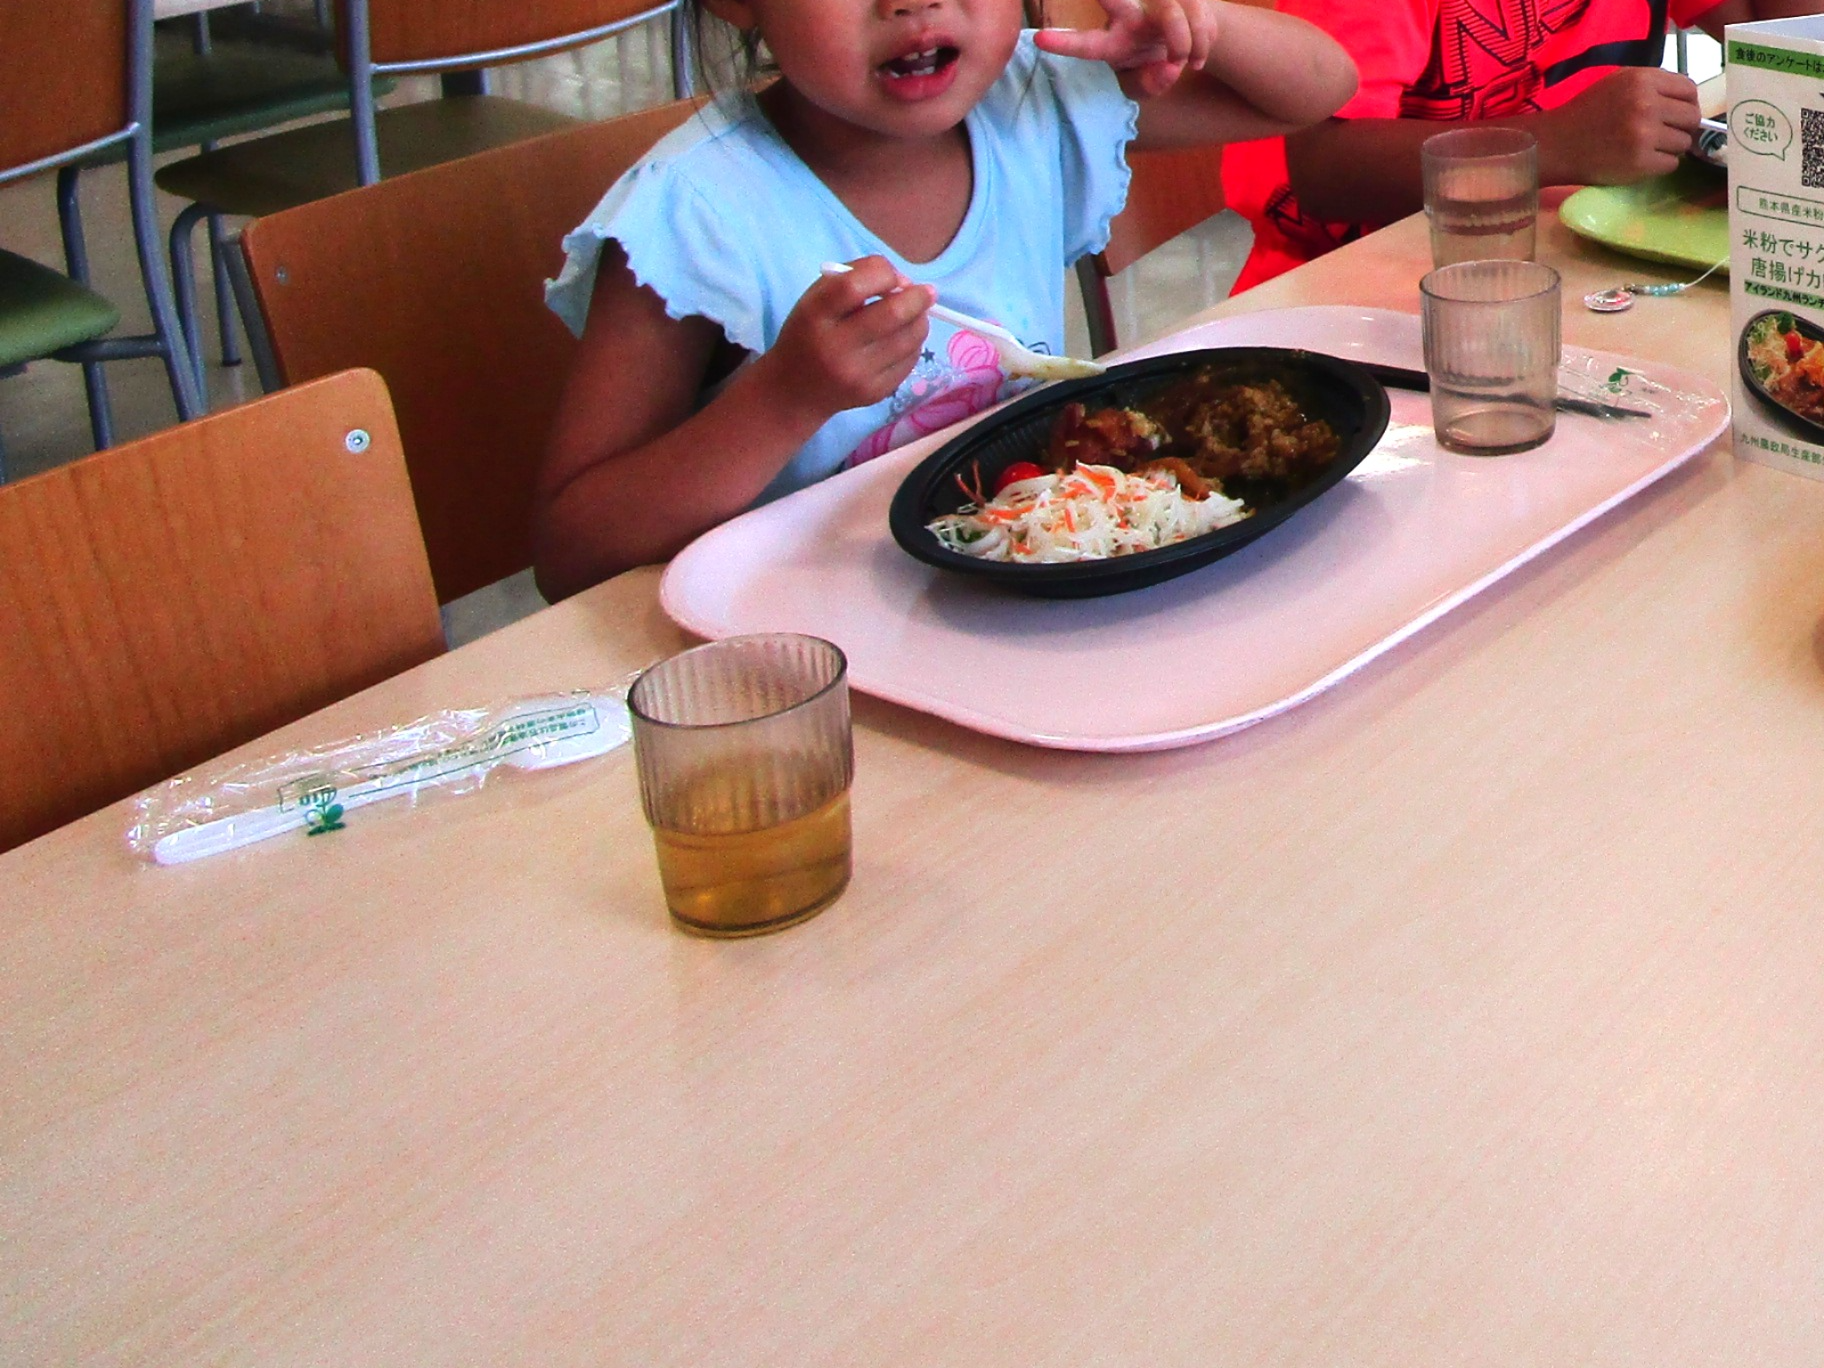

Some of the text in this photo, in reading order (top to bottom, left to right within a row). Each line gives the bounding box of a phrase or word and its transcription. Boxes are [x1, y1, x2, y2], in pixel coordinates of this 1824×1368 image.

[1744, 112, 1776, 130] ご協力
[1742, 126, 1779, 143] ください
